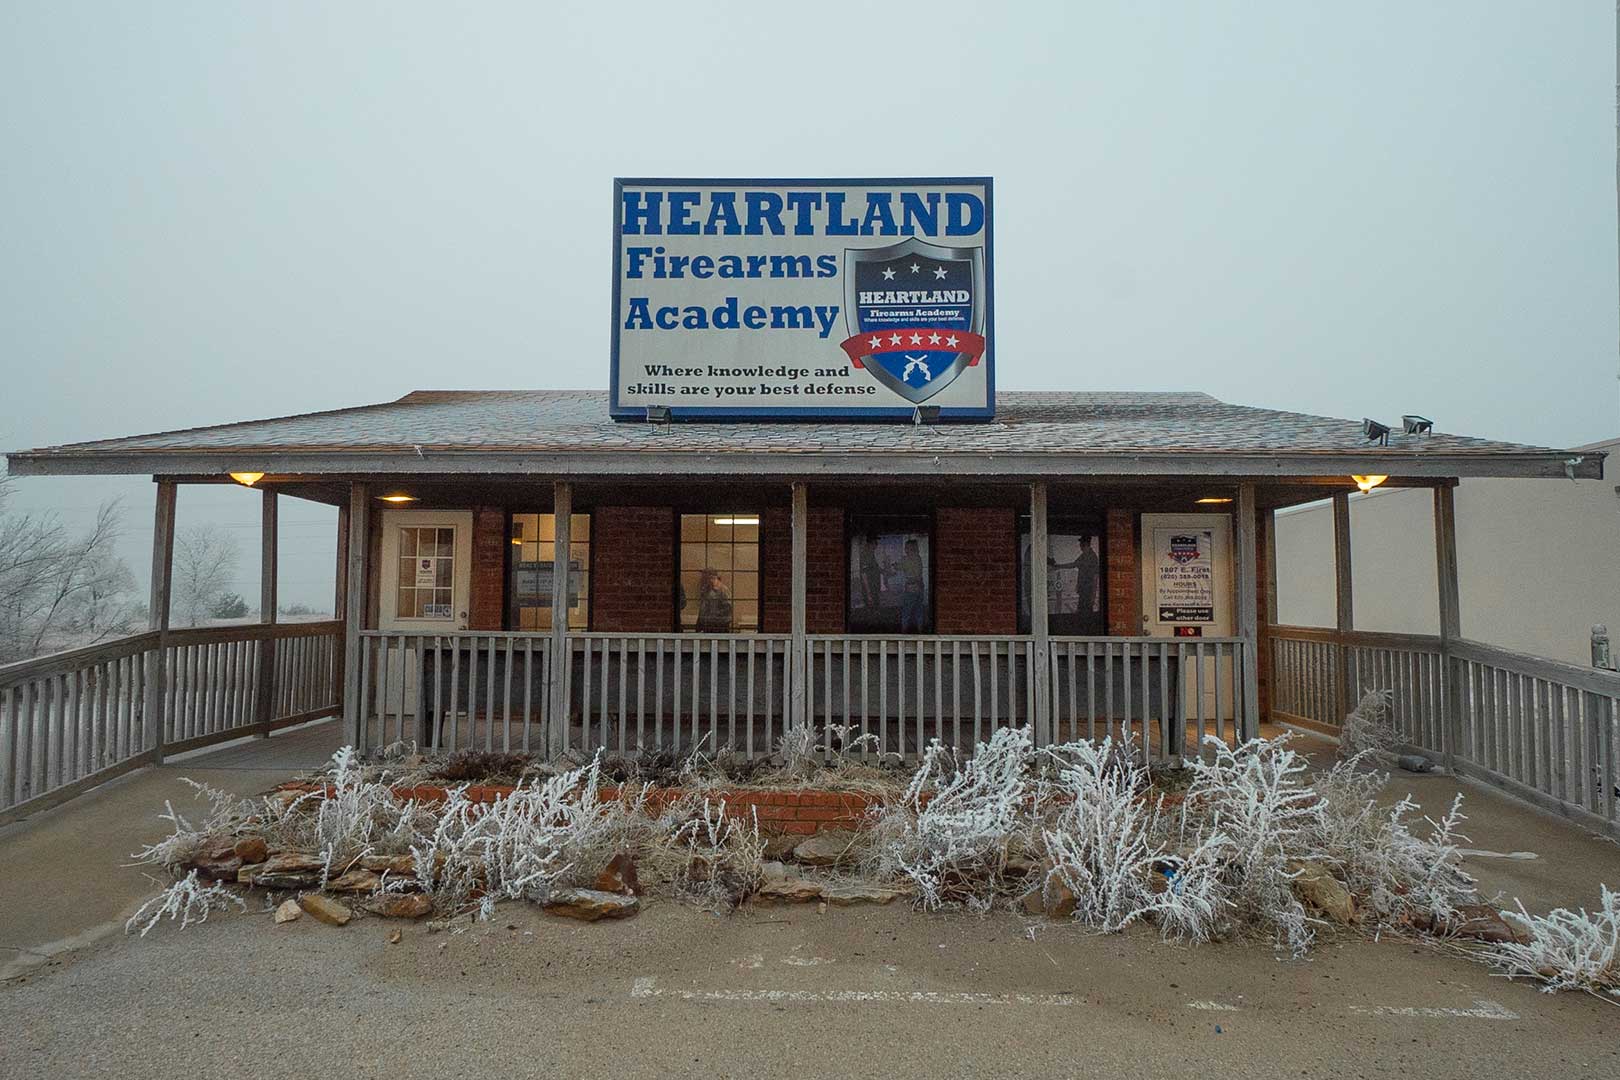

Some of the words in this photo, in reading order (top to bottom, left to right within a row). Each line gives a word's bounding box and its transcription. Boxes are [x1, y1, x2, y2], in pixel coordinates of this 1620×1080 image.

[622, 191, 985, 236] HEARTLAND
[626, 246, 838, 279] Firearms
[859, 290, 970, 304] HEARTLAND
[625, 297, 840, 338] Academy
[870, 309, 914, 317] Firearms
[915, 308, 961, 319] Academy
[645, 364, 704, 378] Where
[707, 364, 810, 381] knowledge
[814, 364, 850, 378] and
[627, 383, 676, 396] skills
[680, 385, 710, 396] are
[714, 385, 757, 398] your
[760, 383, 800, 396] best
[807, 383, 877, 396] defense
